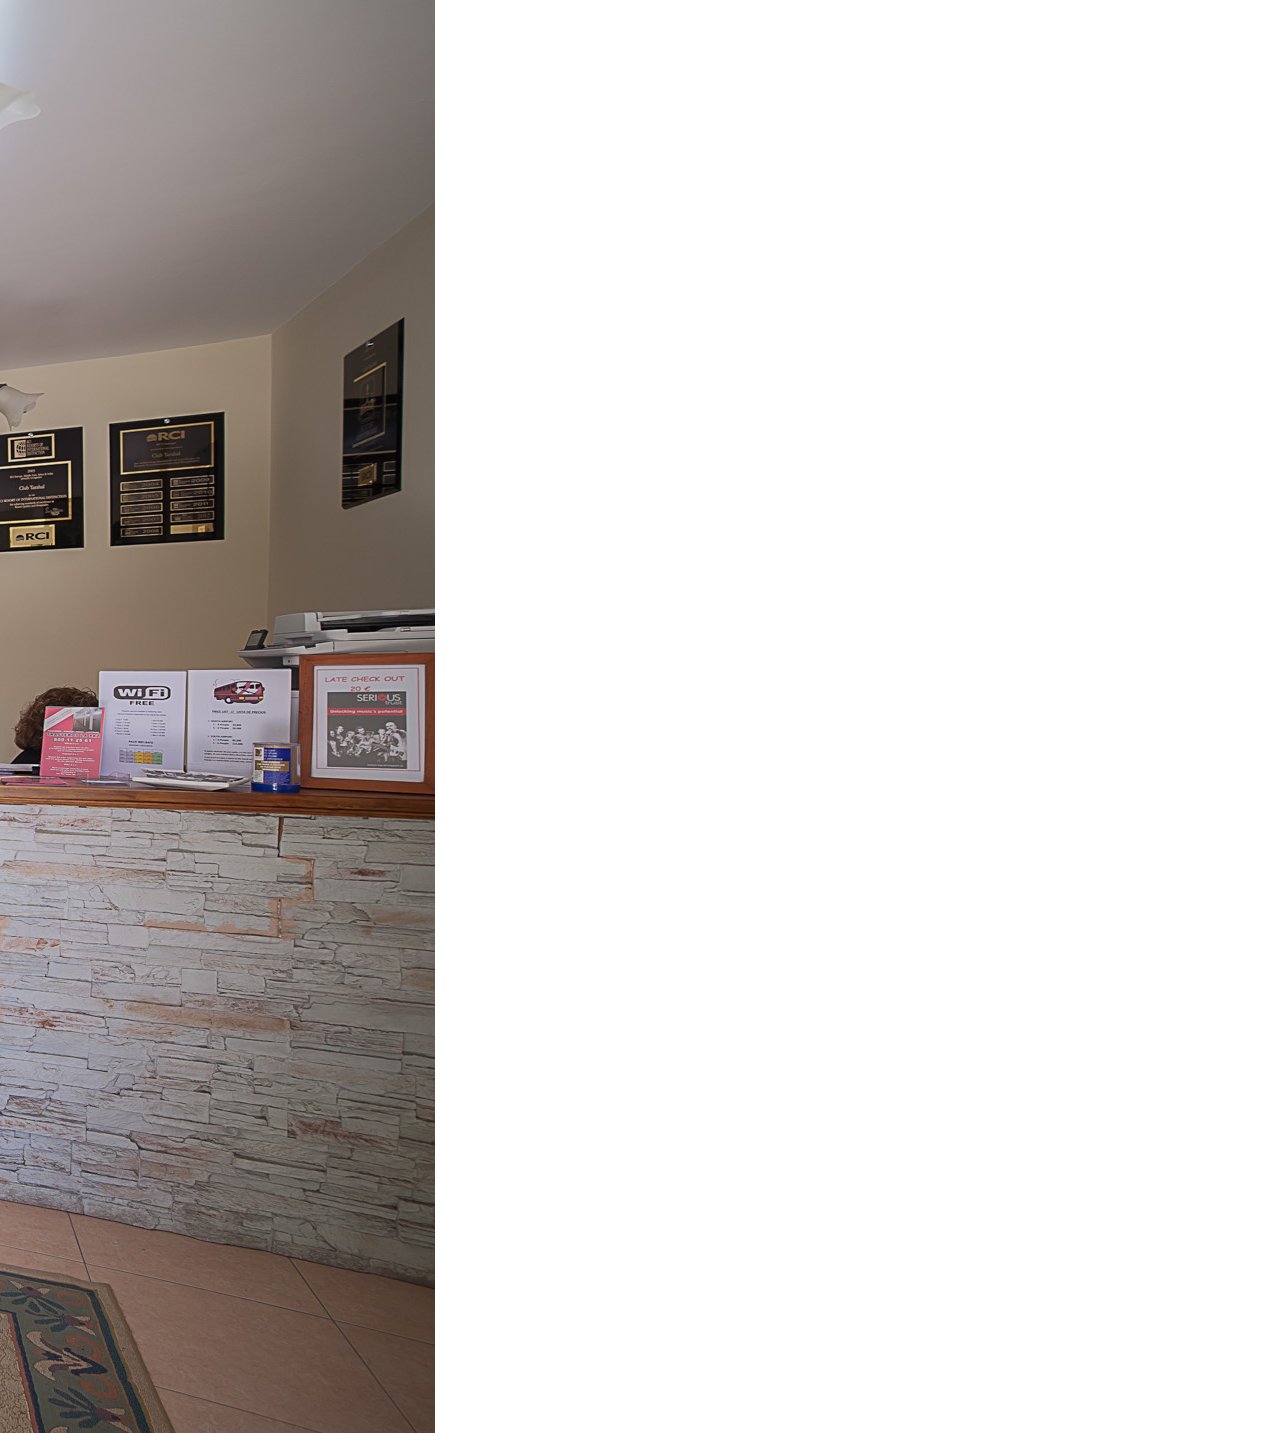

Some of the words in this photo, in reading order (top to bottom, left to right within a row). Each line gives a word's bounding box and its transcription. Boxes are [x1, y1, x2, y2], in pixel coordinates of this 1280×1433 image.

[157, 430, 186, 441] RCI
[25, 532, 50, 541] RCI
[356, 693, 401, 702] SERIOUS
